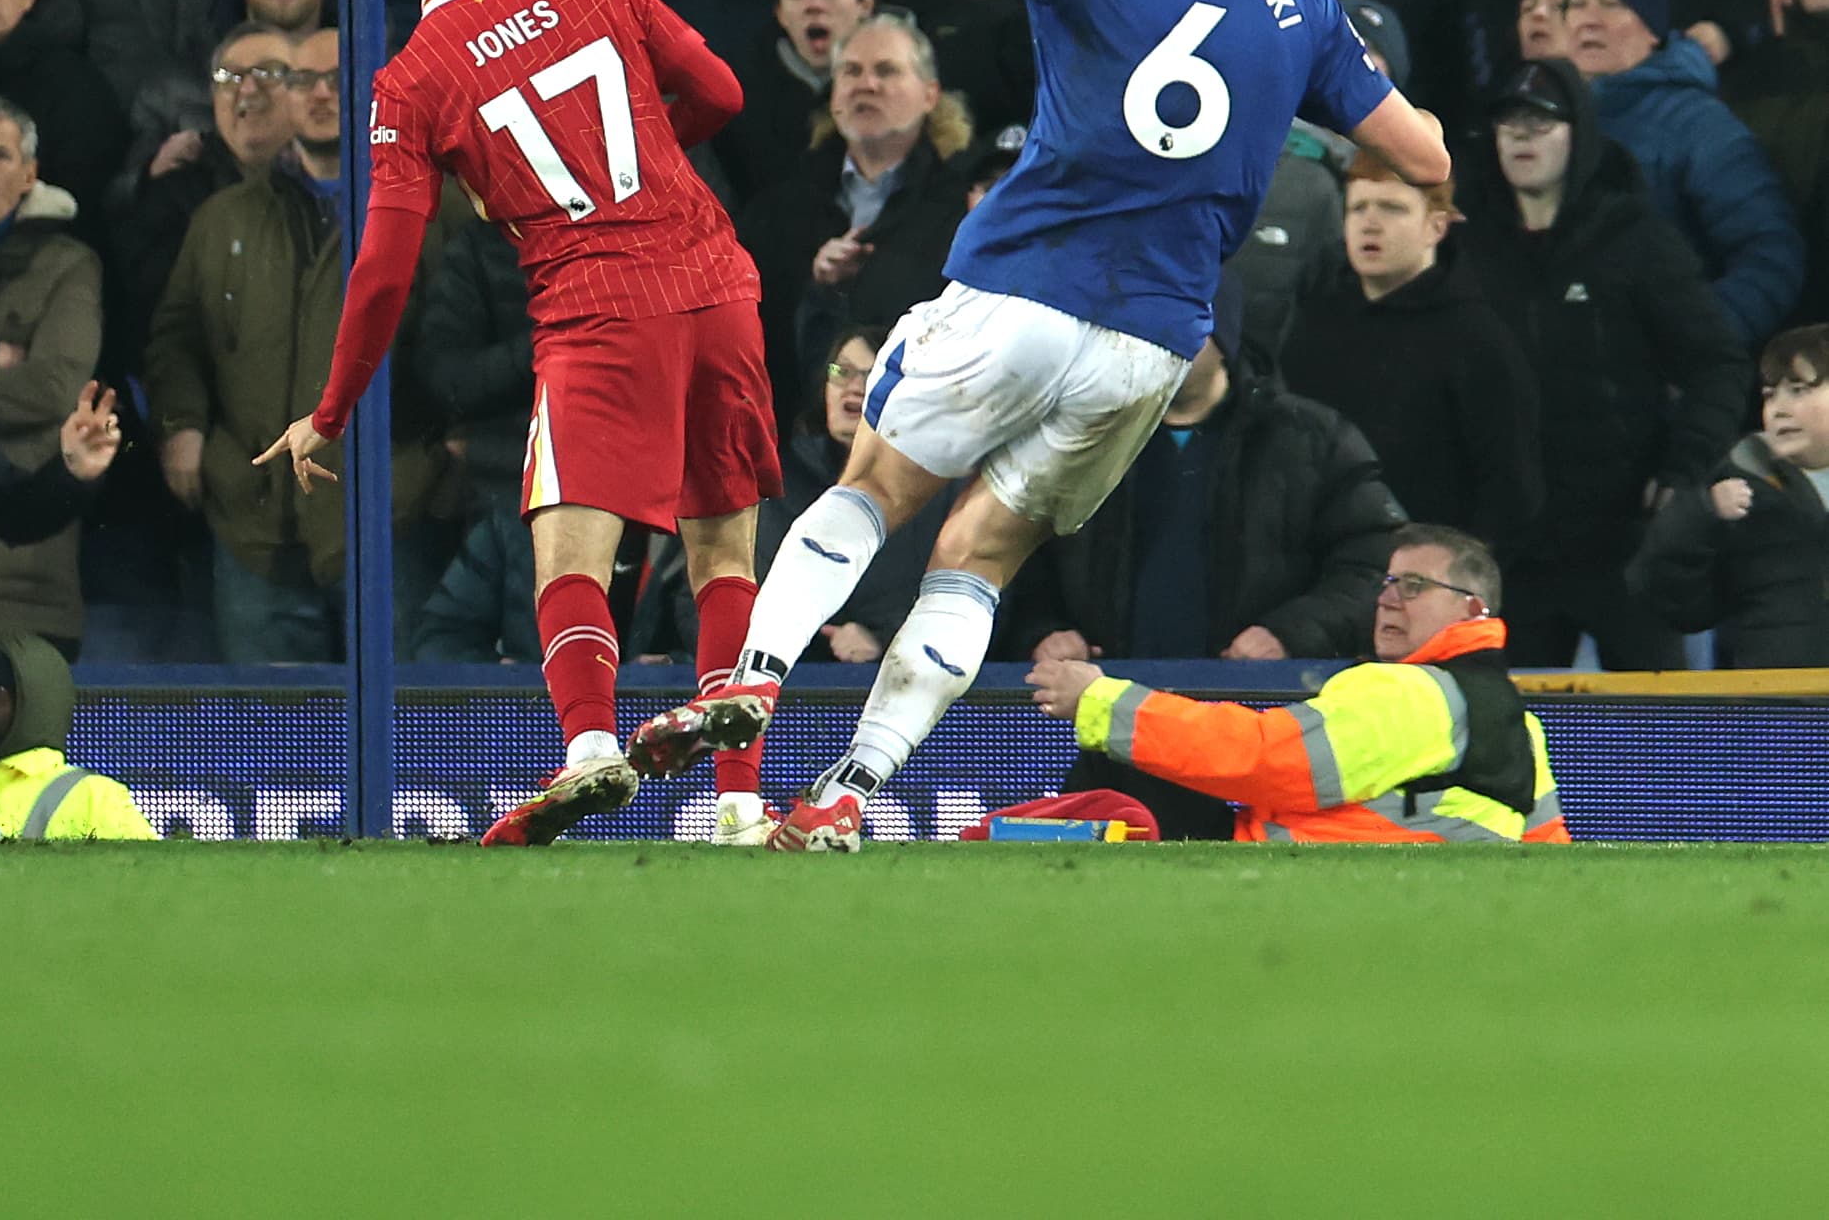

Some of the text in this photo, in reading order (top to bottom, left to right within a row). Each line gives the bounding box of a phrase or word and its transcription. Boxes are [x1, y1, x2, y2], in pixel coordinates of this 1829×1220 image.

[466, 0, 559, 67] JONES
[1123, 1, 1231, 160] 6
[478, 36, 641, 222] 17
